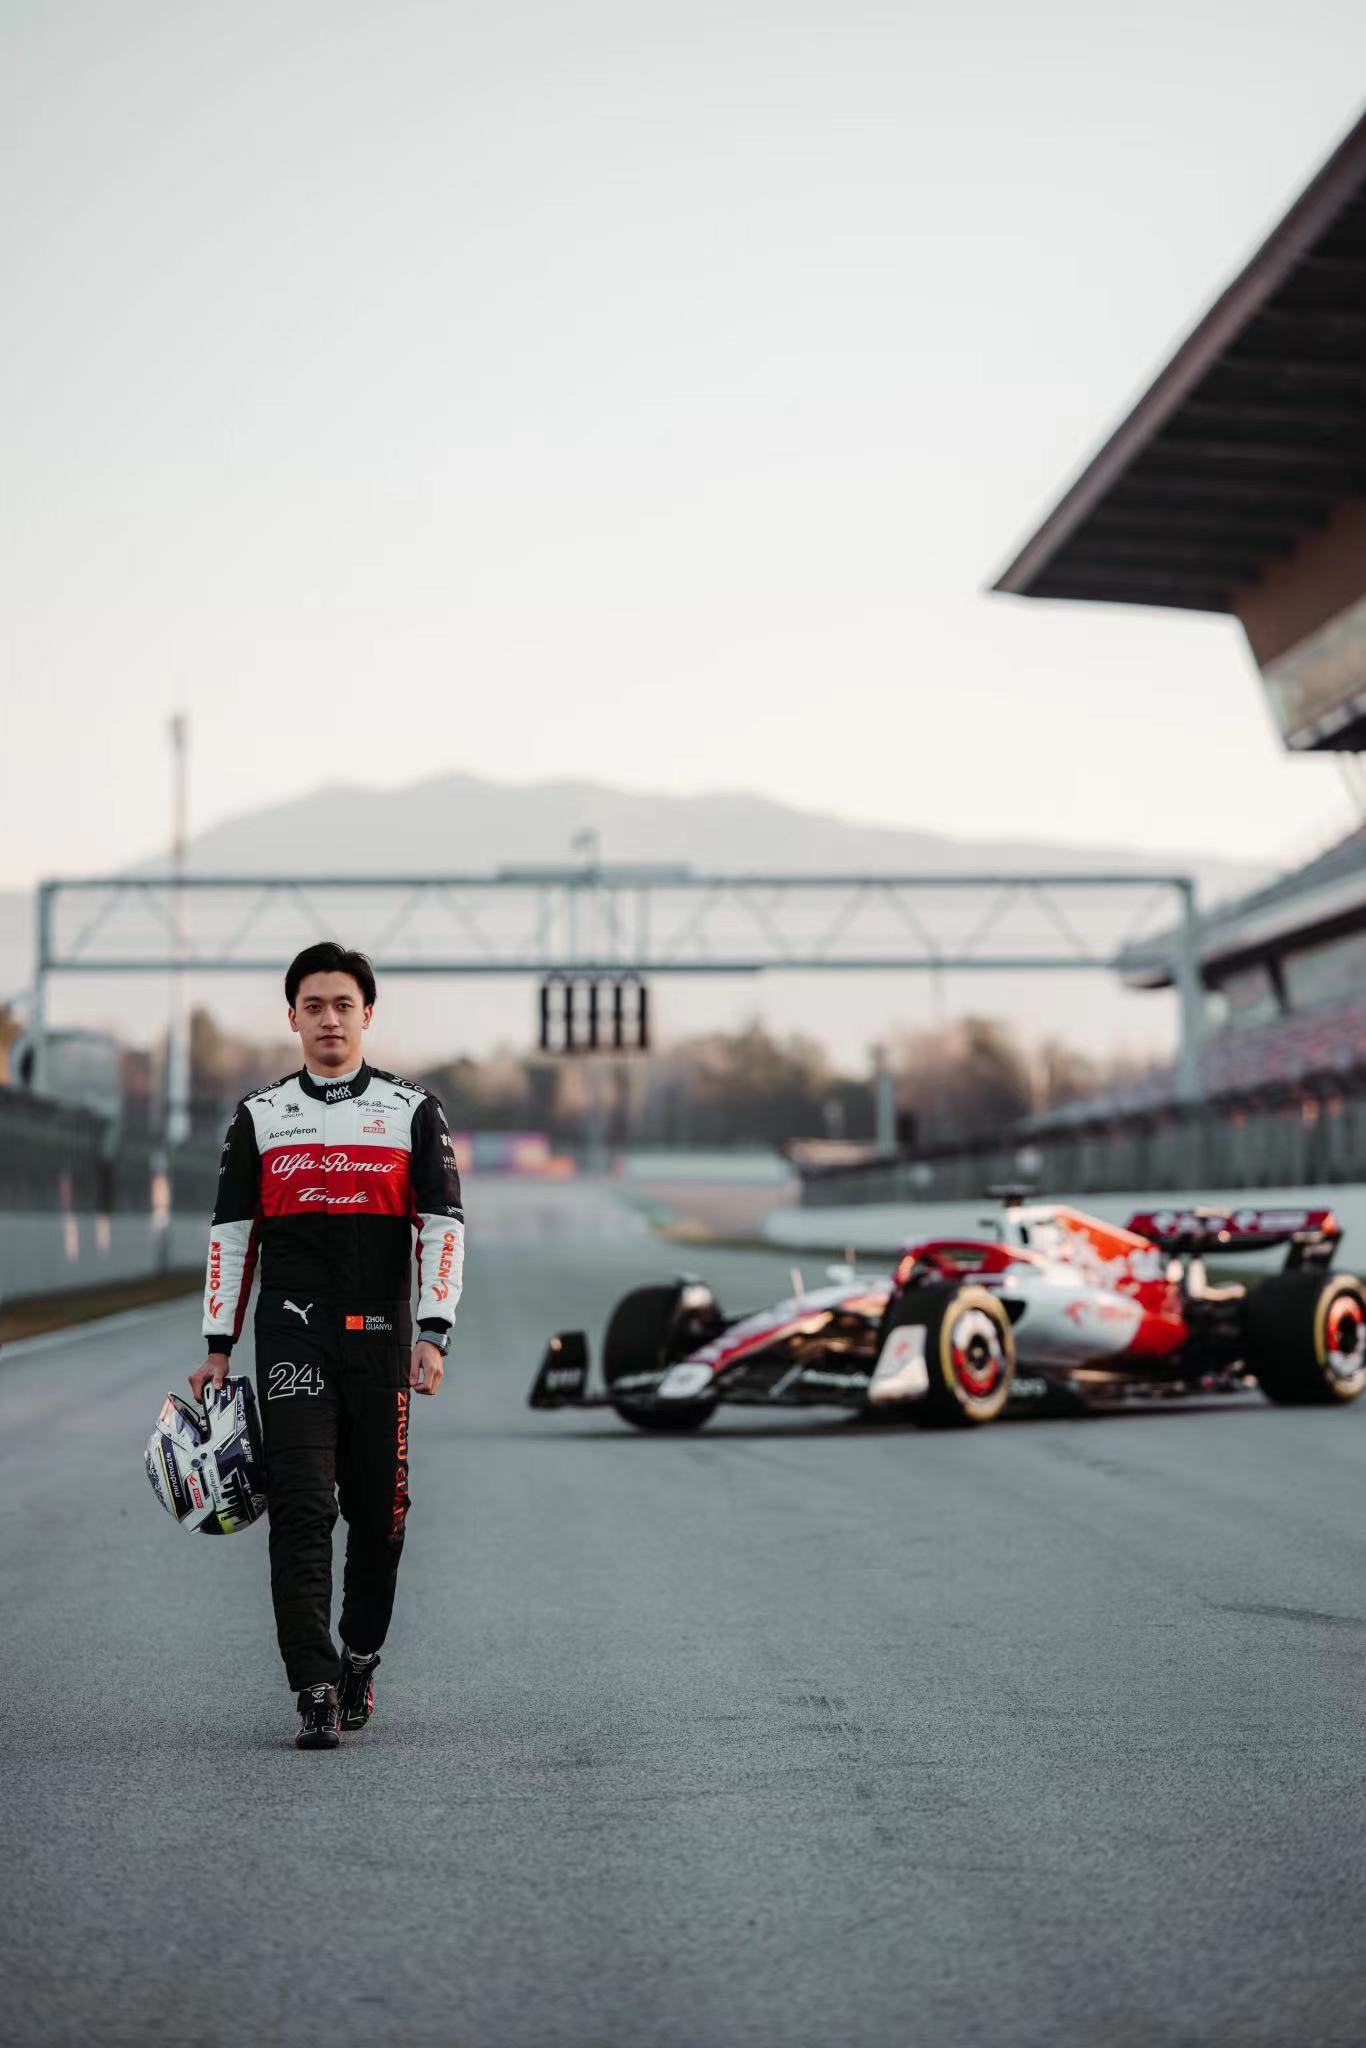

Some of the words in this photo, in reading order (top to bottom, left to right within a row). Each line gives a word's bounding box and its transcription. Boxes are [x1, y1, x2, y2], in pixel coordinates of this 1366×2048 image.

[326, 1085, 352, 1101] AMX
[271, 1152, 320, 1181] Alfa
[320, 1152, 397, 1173] Romeo
[210, 1241, 221, 1291] ORLEN
[438, 1232, 454, 1278] ORLEN
[365, 1315, 385, 1323] ZHOU
[365, 1323, 393, 1331] GUANYU
[268, 1362, 325, 1400] 24
[397, 1392, 408, 1460] ZHOU
[166, 1452, 181, 1498] mindmaze
